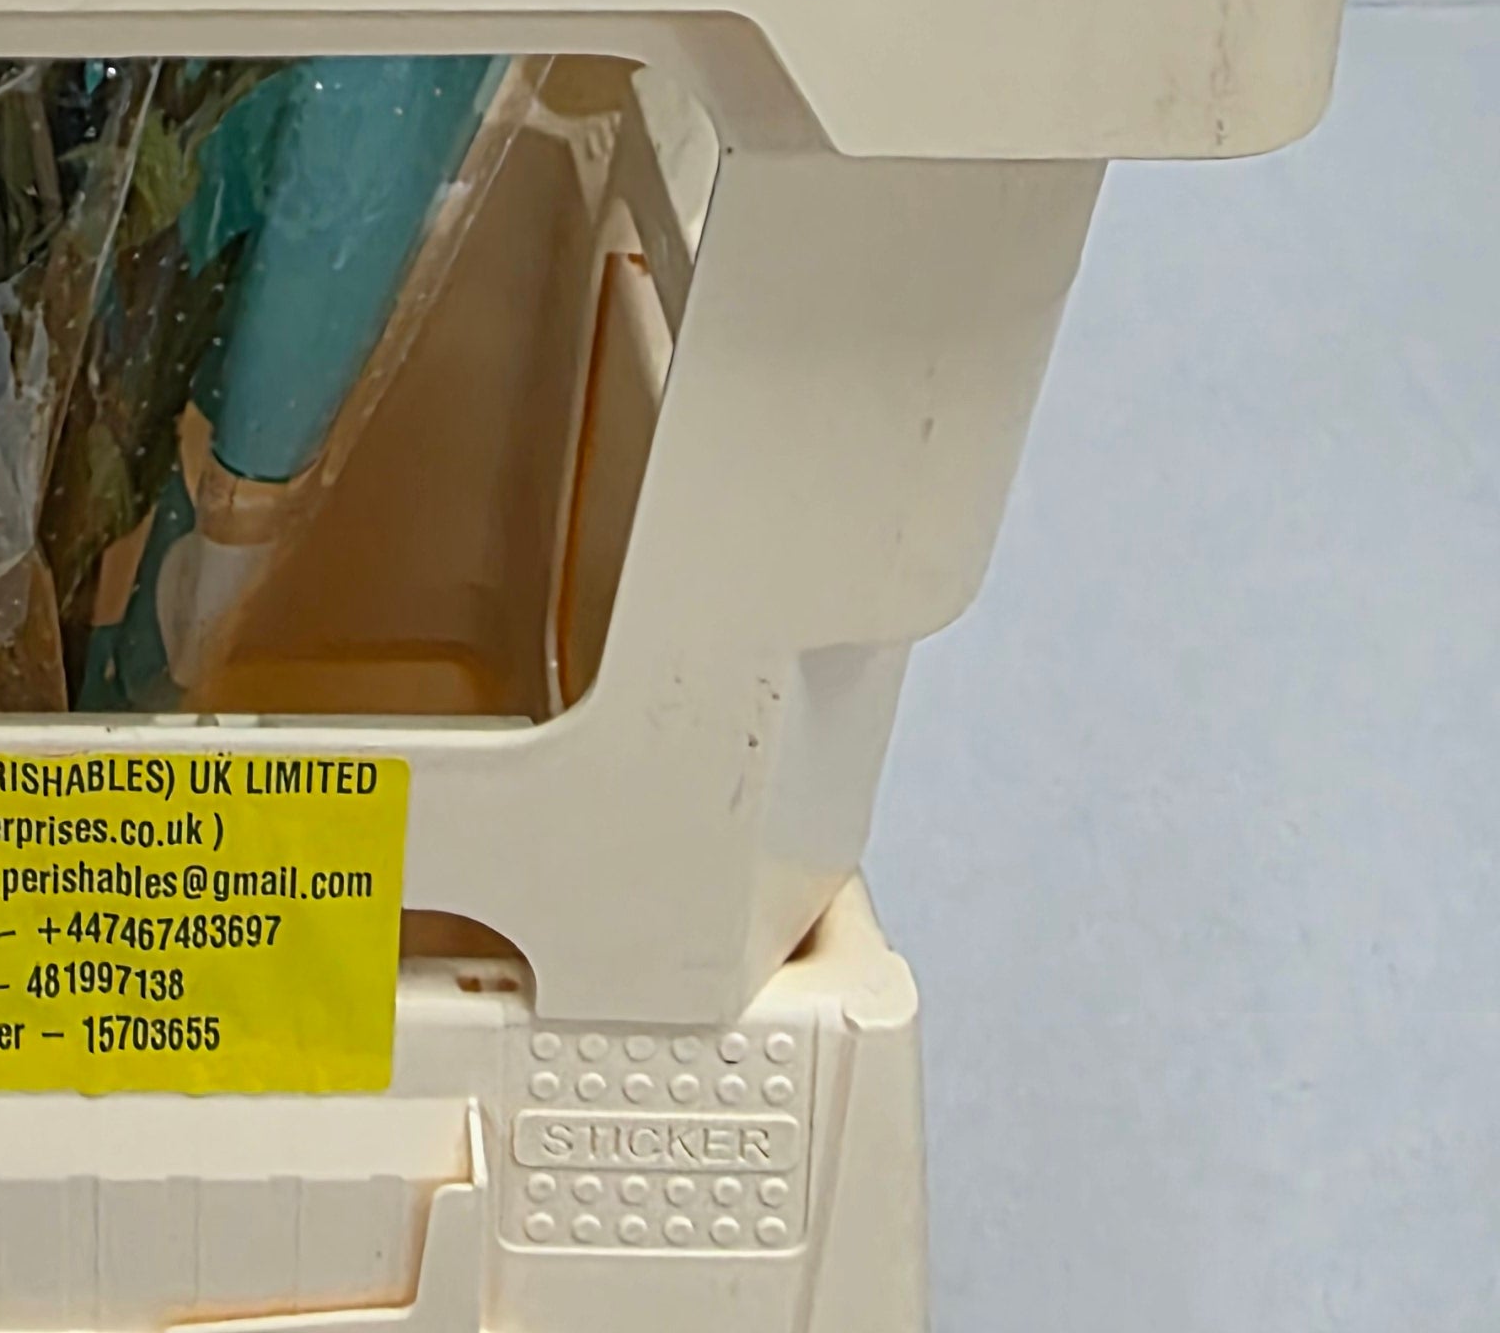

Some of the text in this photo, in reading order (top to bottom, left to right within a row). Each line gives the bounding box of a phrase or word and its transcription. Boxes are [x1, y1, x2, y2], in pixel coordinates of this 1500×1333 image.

[190, 760, 232, 795] UK
[247, 759, 377, 795] LIMITED
[38, 911, 281, 951] +447467483697
[27, 961, 184, 1001] 481997138
[82, 1014, 220, 1054] 15703655
[540, 1124, 771, 1163] STICKER
